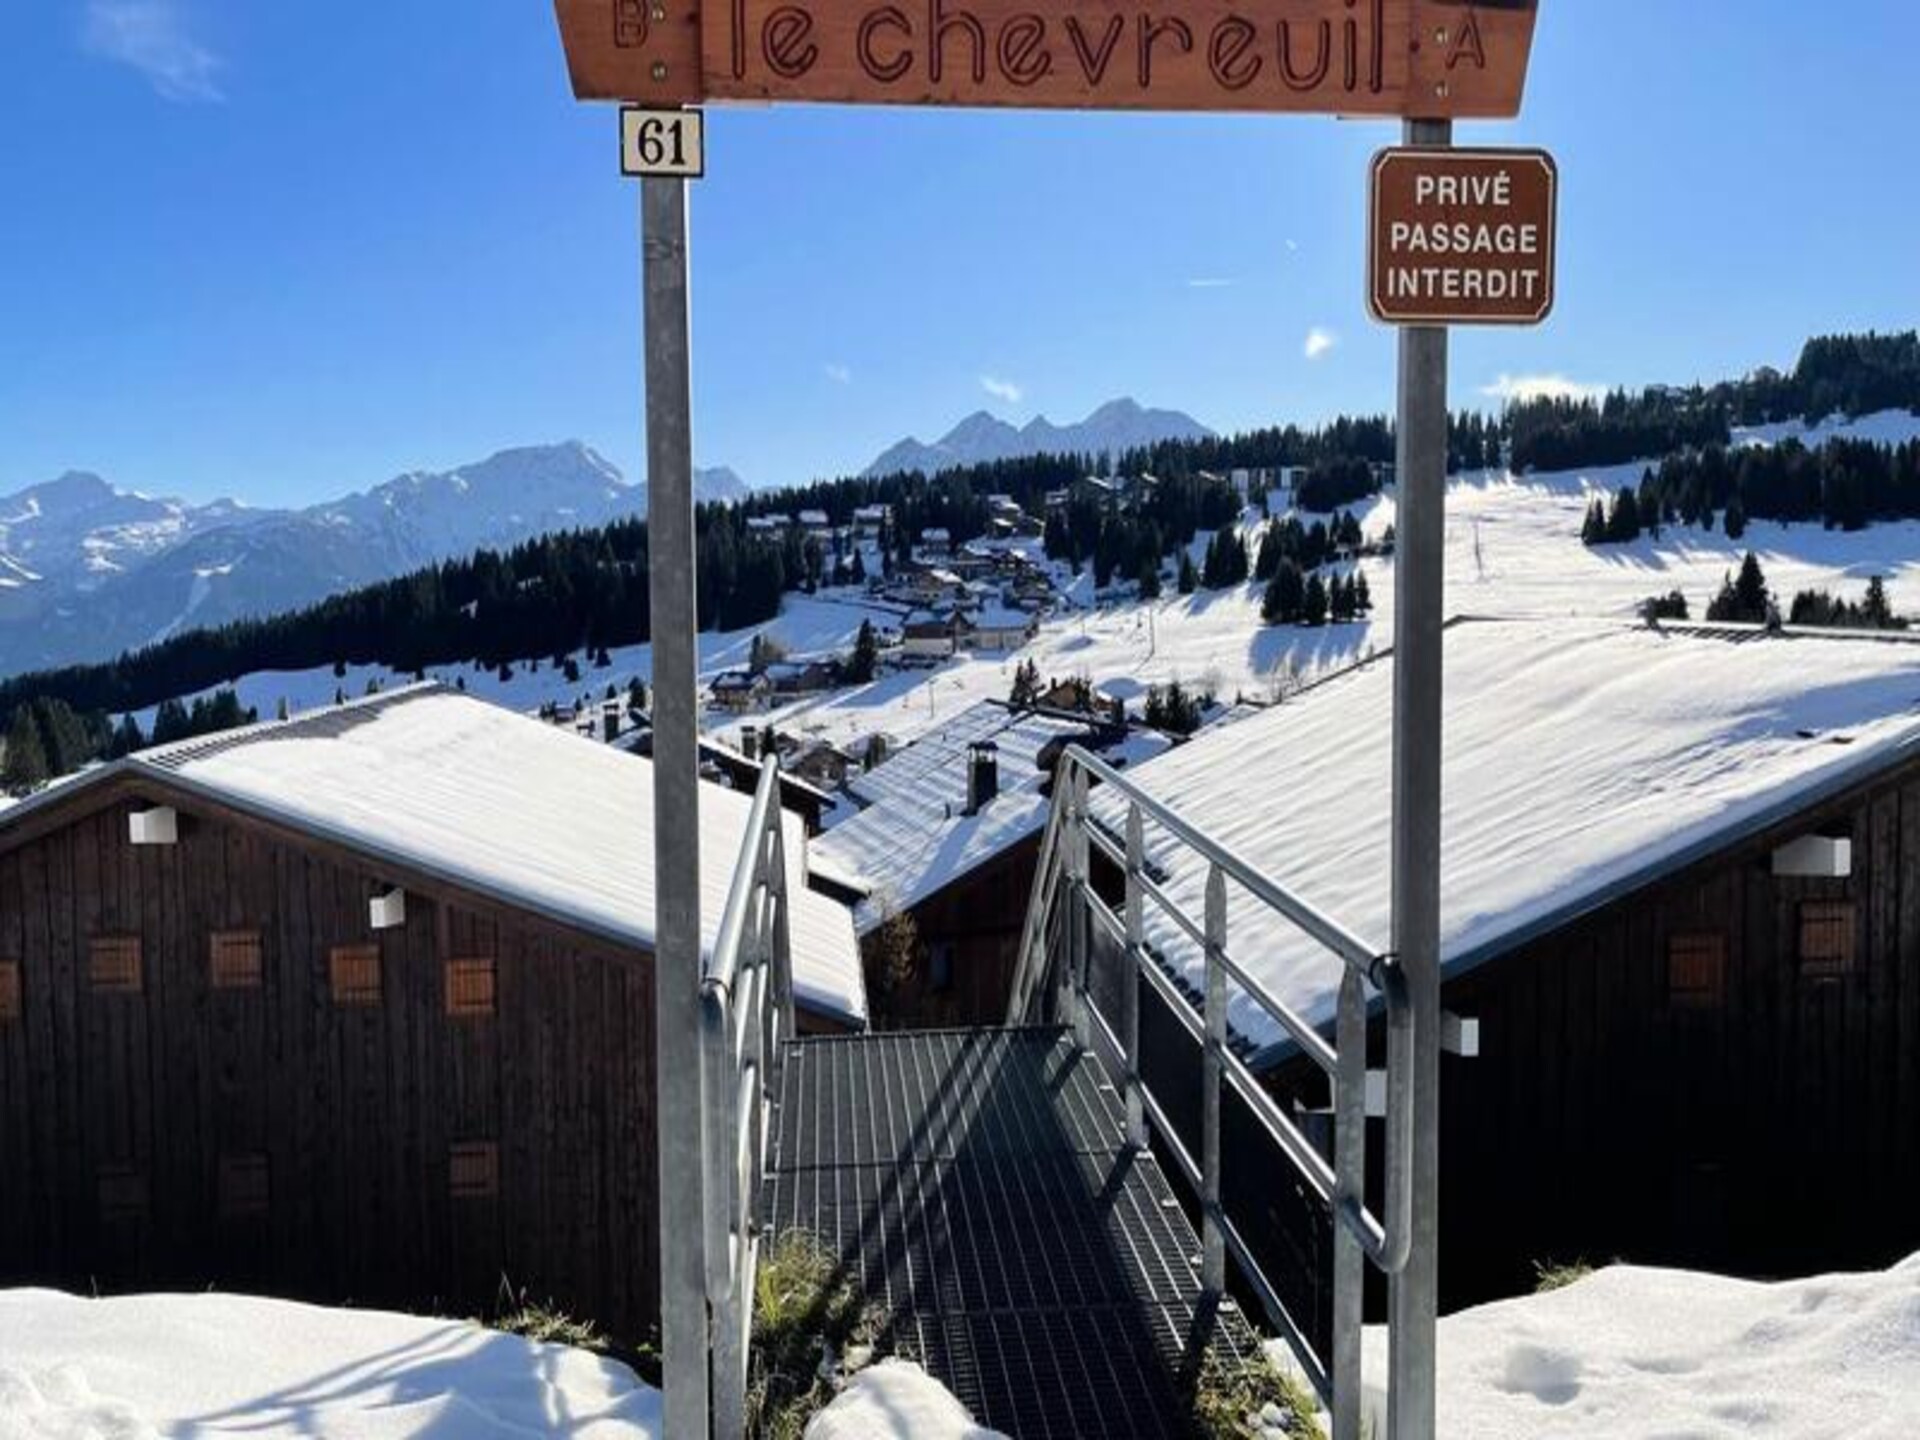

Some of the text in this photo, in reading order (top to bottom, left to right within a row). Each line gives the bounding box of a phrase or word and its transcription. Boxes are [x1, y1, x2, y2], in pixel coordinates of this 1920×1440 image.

[613, 0, 649, 48] B
[731, 0, 1383, 94] le chevreuil
[1445, 8, 1486, 70] A
[637, 118, 686, 166] 61
[1416, 171, 1511, 206] PRIVÉ
[1391, 222, 1538, 254] PASSAGE
[1387, 268, 1539, 300] INTERDIT
